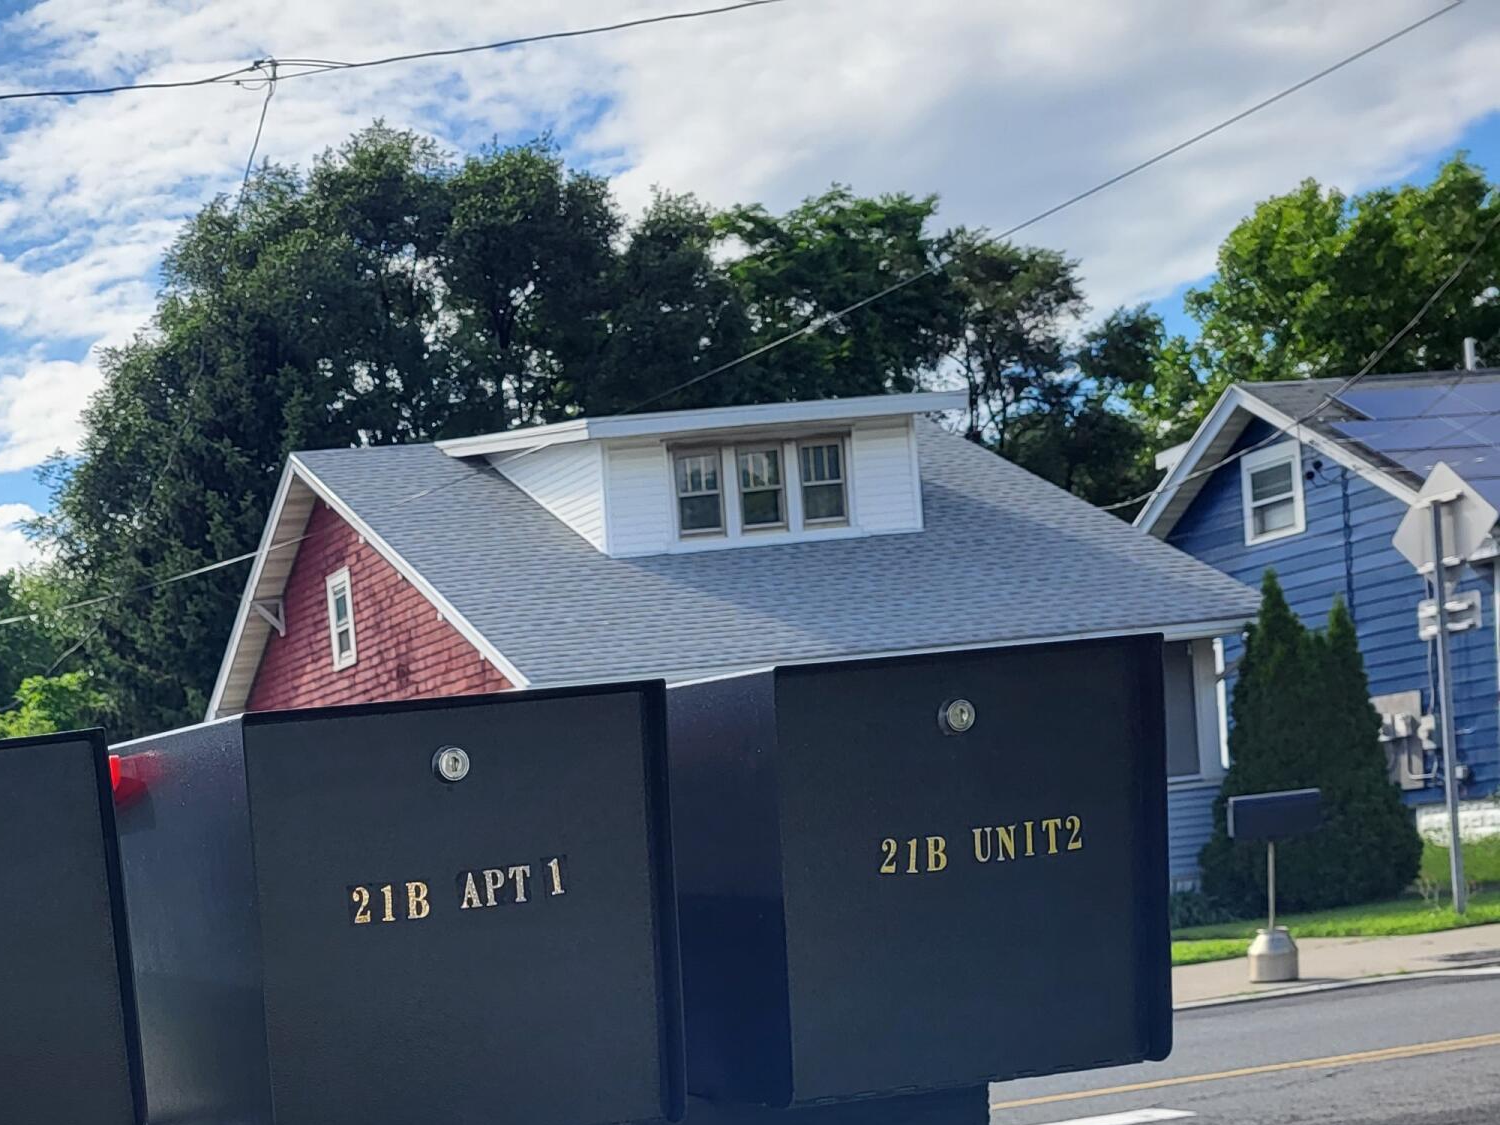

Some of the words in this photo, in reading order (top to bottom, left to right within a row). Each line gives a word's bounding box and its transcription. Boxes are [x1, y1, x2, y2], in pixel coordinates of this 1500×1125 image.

[879, 835, 948, 874] 21B
[971, 815, 1083, 863] UNIT2
[352, 881, 430, 924] 21B
